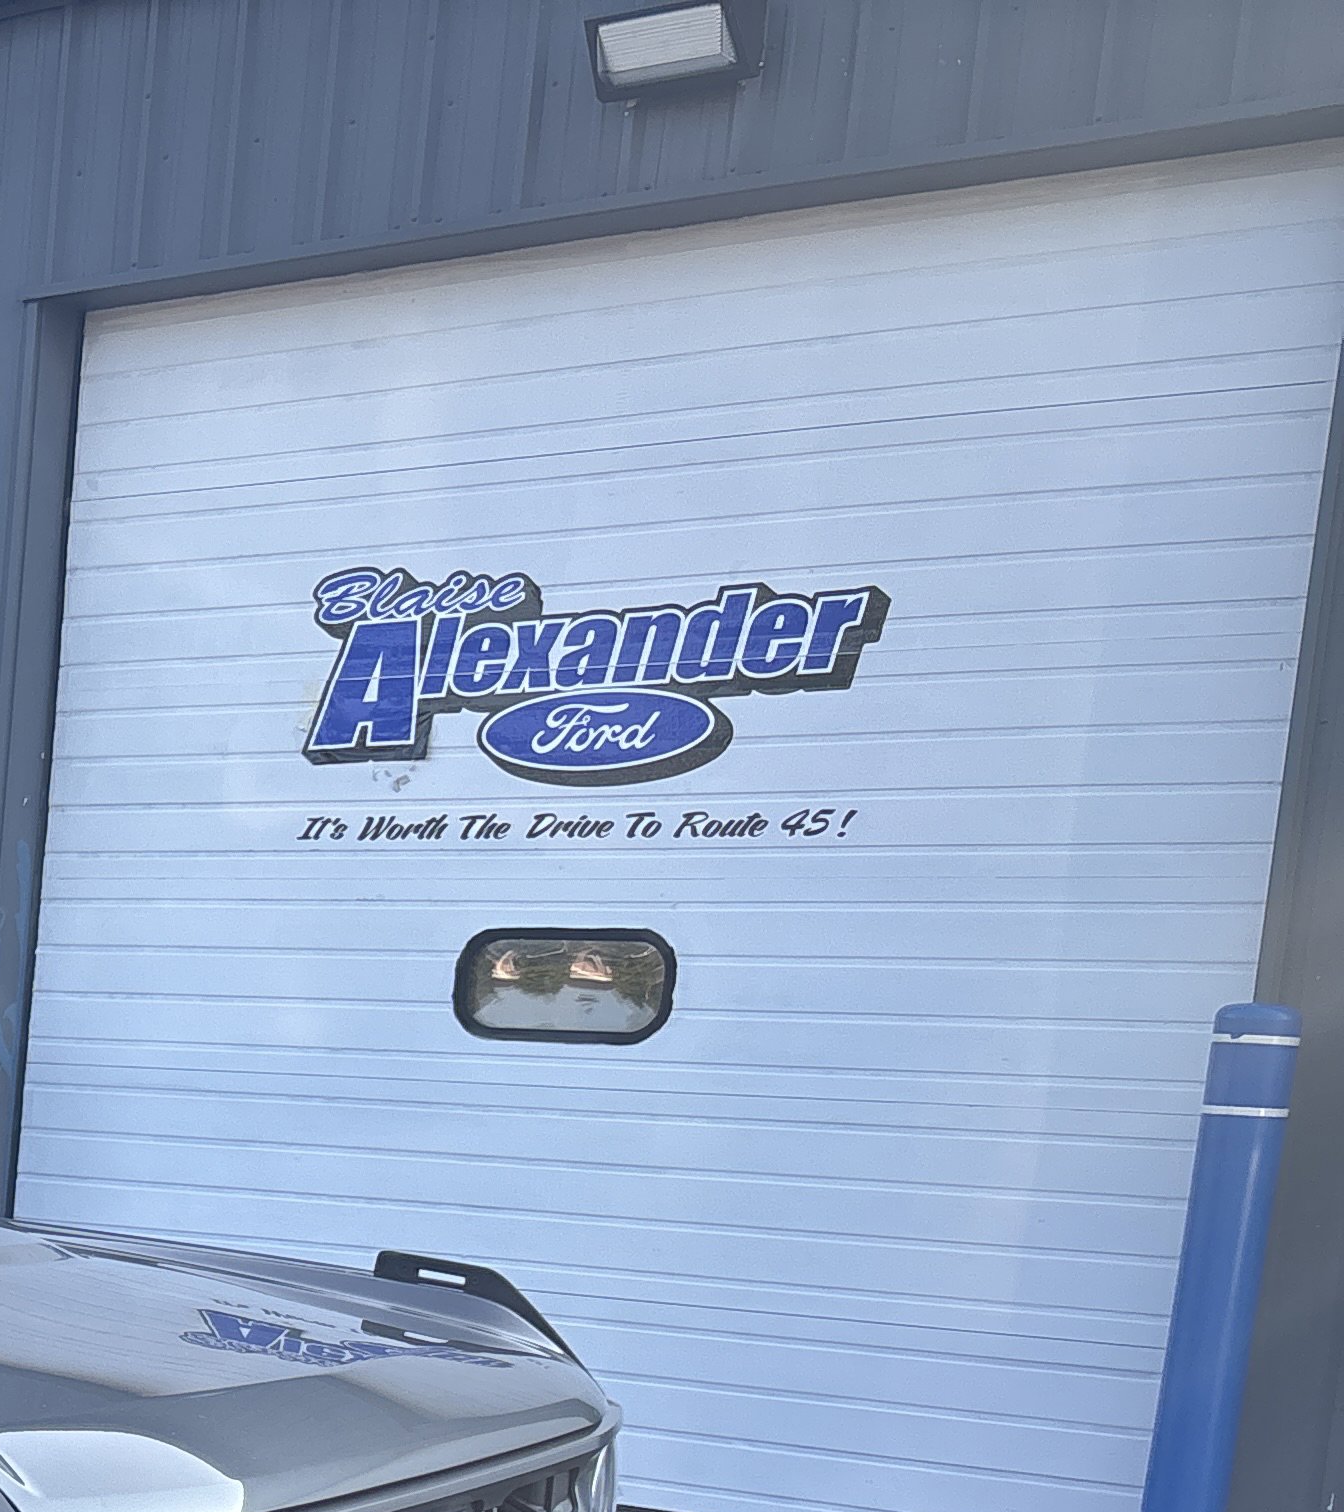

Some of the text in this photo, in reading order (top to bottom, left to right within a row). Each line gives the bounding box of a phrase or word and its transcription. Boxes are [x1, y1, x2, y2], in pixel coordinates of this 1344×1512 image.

[317, 571, 526, 625] Blaise
[307, 586, 872, 752] Alexander
[530, 702, 661, 754] Ford
[296, 815, 348, 841] It's
[356, 813, 449, 841] Worth
[459, 812, 512, 841] The
[525, 812, 615, 840] Drive
[625, 810, 663, 839] To
[672, 810, 769, 839] Route
